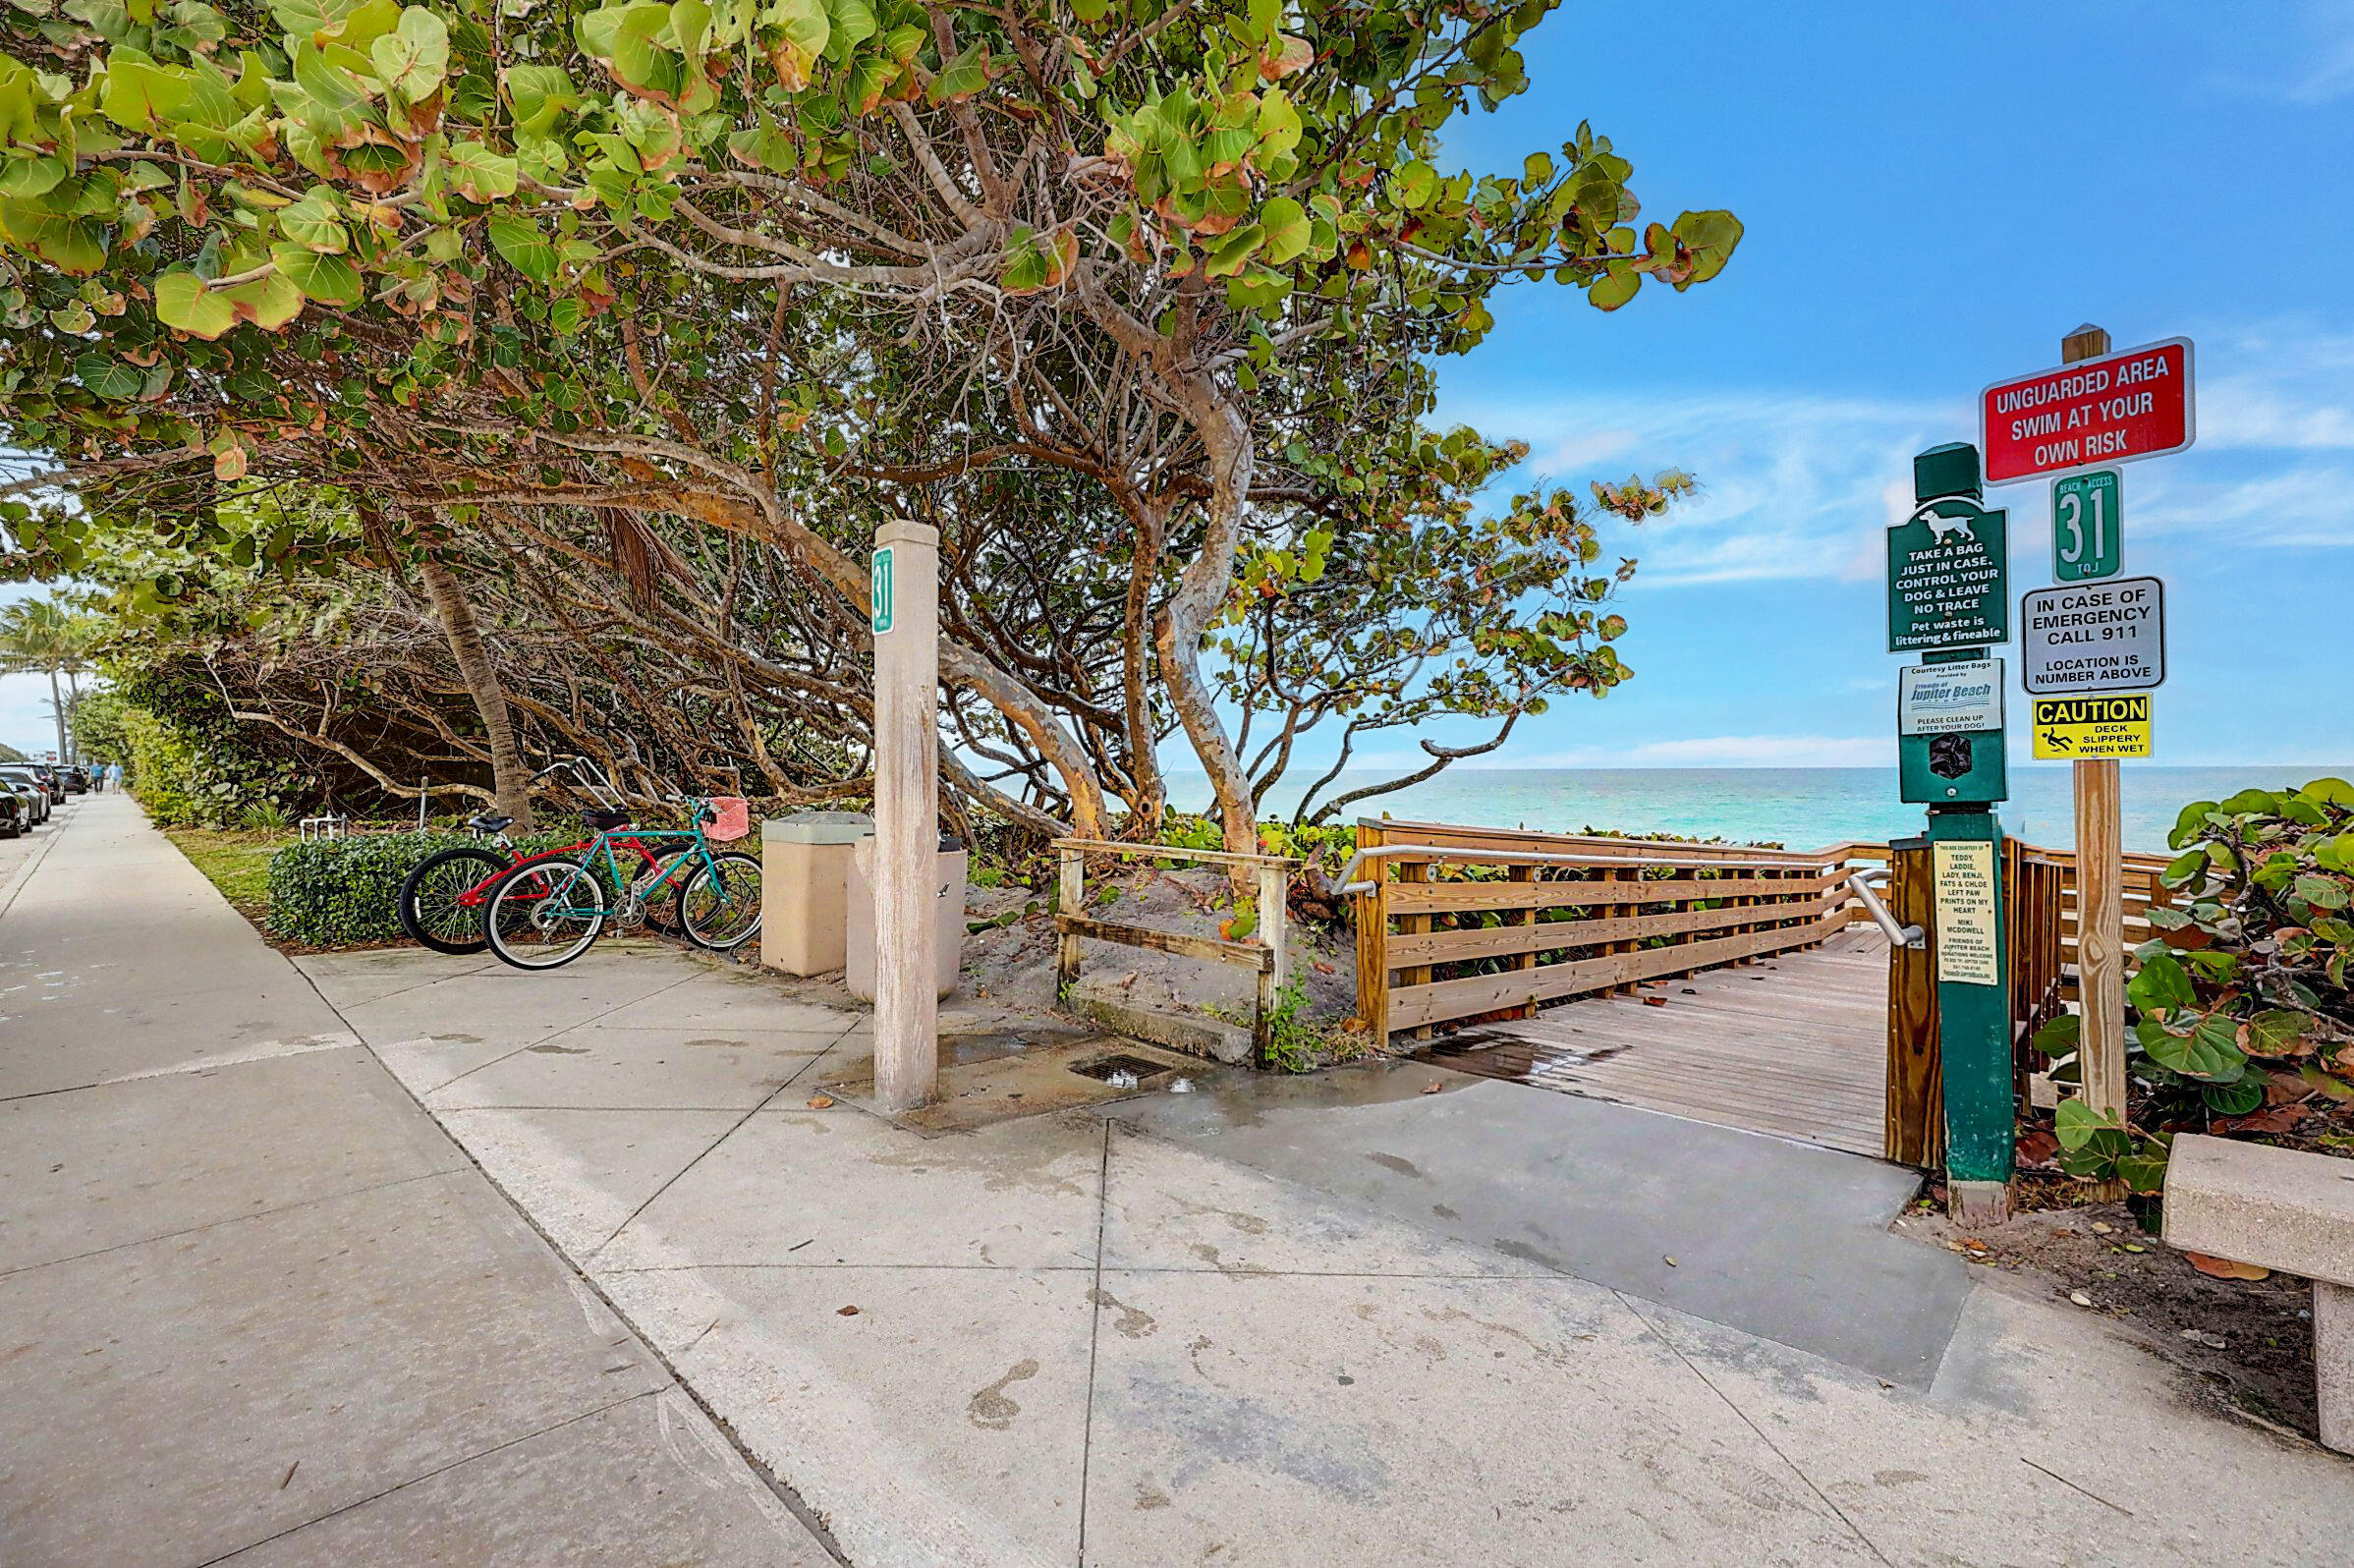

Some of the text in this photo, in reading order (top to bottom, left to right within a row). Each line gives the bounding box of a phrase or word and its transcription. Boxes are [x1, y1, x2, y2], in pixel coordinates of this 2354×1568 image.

[1997, 356, 2168, 414] UNGUARDED AREA
[2011, 392, 2153, 441] SWIM AT YOUR
[2035, 429, 2127, 467] OWN RISK
[2059, 476, 2113, 494] BEACH ACCESS
[2059, 488, 2104, 563] 31
[1909, 543, 1984, 561] TAKE A BAG
[1901, 556, 1992, 576] JUST IN CASE.
[1895, 569, 1998, 589] CONTROL YOUR
[874, 562, 888, 619] 31
[1904, 584, 1990, 602] DOG & LEAVE
[1914, 598, 1980, 614] NO TRACE
[2037, 588, 2147, 612] IN CASE OF
[1911, 616, 1985, 632] Pet waste is
[2033, 606, 2151, 630] EMERGENCY
[1895, 634, 1941, 645] littering
[1953, 628, 2001, 641] fineable
[2047, 625, 2137, 645] CALL 911
[1911, 666, 1946, 675] Courtesy
[1971, 661, 1991, 670] Bags
[2046, 655, 2139, 671] LOCATION IS
[2035, 666, 2152, 684] NUMBER ABOVE
[1911, 683, 1991, 701] Jupiter Beach
[2038, 699, 2146, 723] CAUTION
[2083, 734, 2141, 744] SLIPPERY
[2079, 744, 2145, 754] WHEN WET
